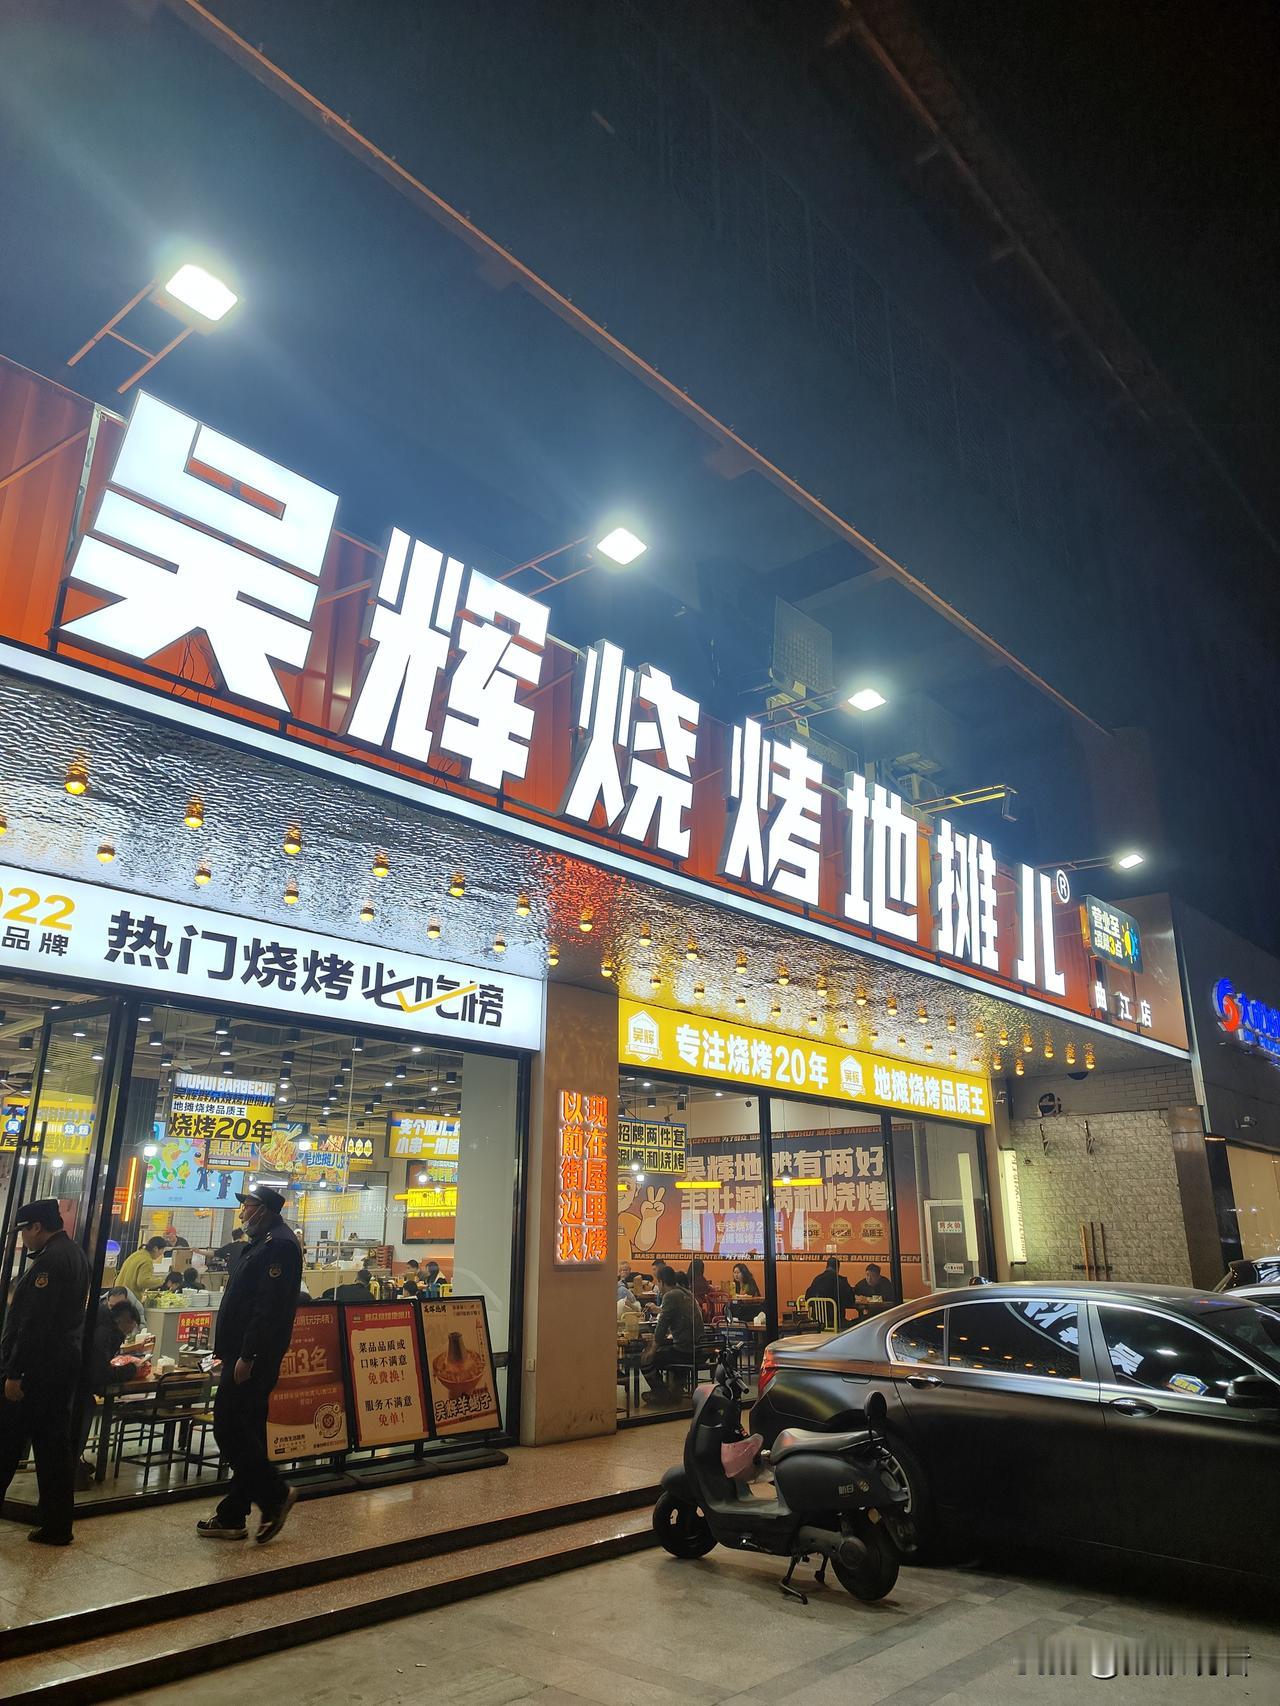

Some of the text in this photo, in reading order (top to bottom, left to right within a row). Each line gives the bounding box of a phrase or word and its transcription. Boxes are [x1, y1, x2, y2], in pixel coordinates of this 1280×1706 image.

[59, 390, 1066, 997] 吴辉烧烤地摊儿
[0, 886, 76, 932] 22
[1, 925, 70, 958] 品牌
[103, 909, 504, 1028] 热门烧烤必吃榜
[675, 1023, 829, 1090] 专注烧烤20年
[873, 1063, 985, 1117] 地摊烧烤品质王
[173, 1100, 246, 1117] 地摊烧烤品质王
[167, 1113, 273, 1144] 烧烤20年
[618, 1123, 685, 1147] 招牌两件套
[559, 1090, 584, 1262] 以前街边找
[584, 1094, 609, 1262] 现在屋里烤
[716, 1221, 784, 1233] 专注烧烤2年
[359, 1339, 406, 1354] 菜品品质或
[361, 1354, 408, 1369] 口味不满意
[368, 1369, 405, 1385] 免费换！
[364, 1396, 413, 1412] 服务不满意
[378, 1412, 405, 1426] 免单！
[434, 1391, 492, 1421] 吴辉羊蝎子
